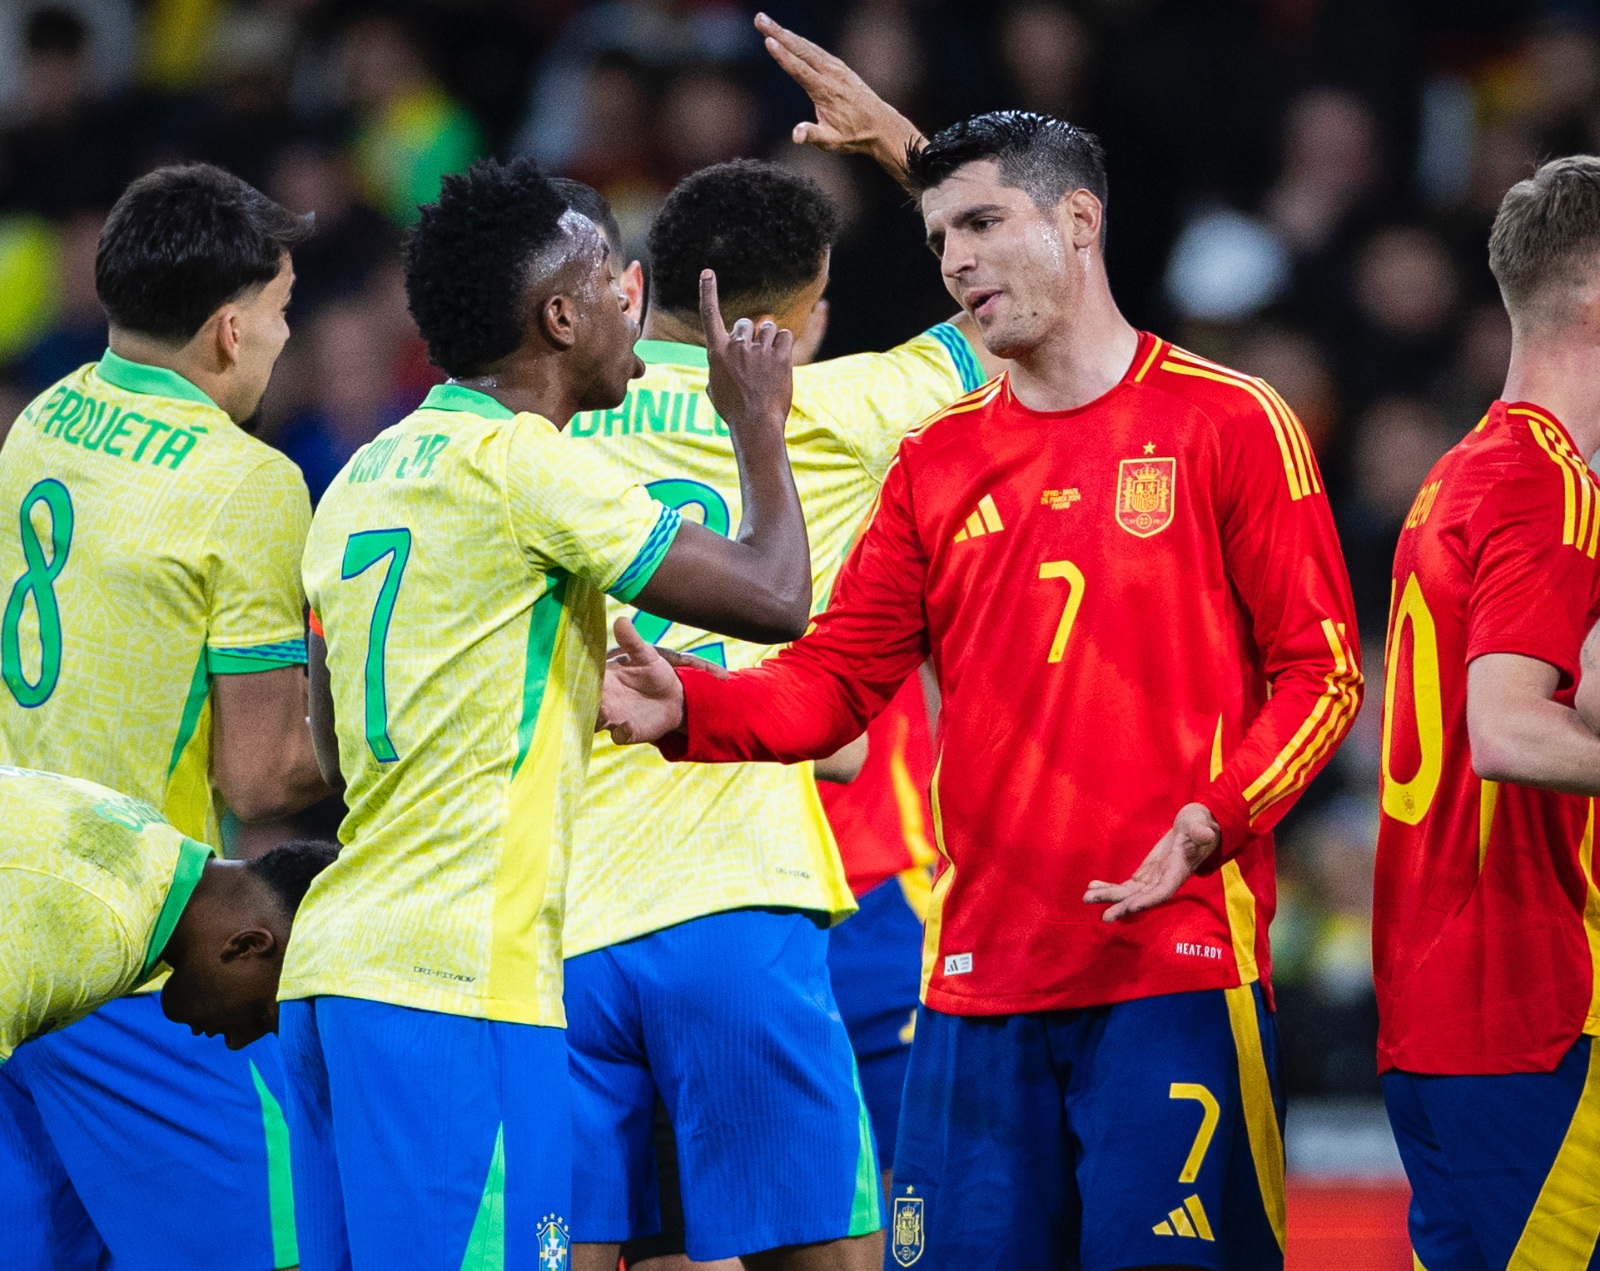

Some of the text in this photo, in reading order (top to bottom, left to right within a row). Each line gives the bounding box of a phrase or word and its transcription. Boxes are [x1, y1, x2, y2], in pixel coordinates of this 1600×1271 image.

[1, 478, 74, 708] 8
[341, 527, 412, 762] 7
[1038, 560, 1086, 663] 7
[1382, 571, 1444, 826] 0
[1176, 942, 1223, 959] HEAT.RDY
[1168, 1082, 1221, 1183] 7
